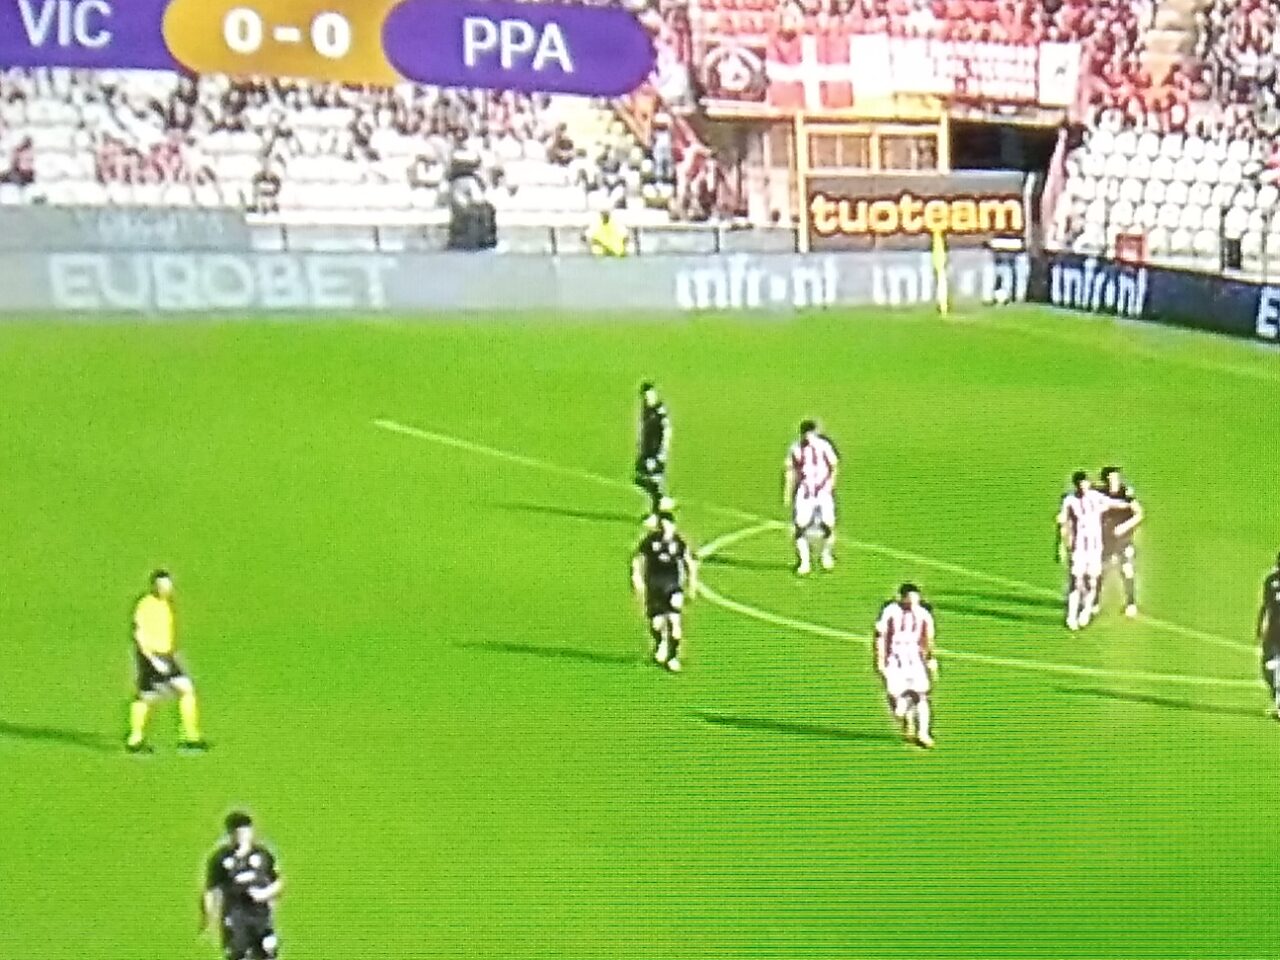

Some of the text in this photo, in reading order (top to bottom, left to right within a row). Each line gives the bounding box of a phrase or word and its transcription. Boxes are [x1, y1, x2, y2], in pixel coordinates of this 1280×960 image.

[19, 0, 113, 46] VIC
[462, 17, 574, 73] PPA
[810, 195, 1023, 232] tuoteam
[49, 253, 398, 307] EUROBET
